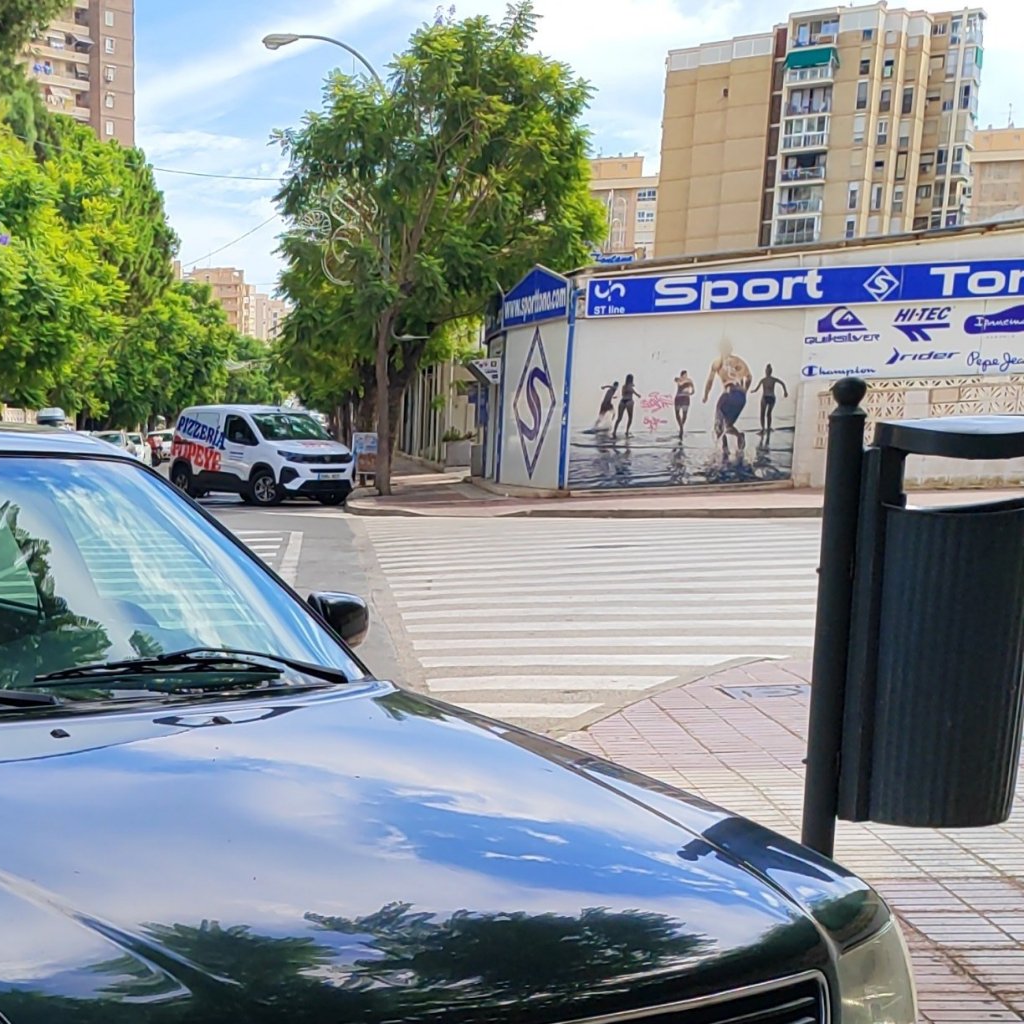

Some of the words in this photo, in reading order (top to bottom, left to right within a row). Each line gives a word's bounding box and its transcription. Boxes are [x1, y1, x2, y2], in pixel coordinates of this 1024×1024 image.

[654, 269, 824, 311] Sport
[593, 306, 606, 315] ST
[608, 306, 625, 314] line
[899, 350, 961, 361] rider
[967, 351, 999, 372] Pepe
[802, 365, 876, 377] Champion
[177, 415, 226, 450] PIZZERÍA
